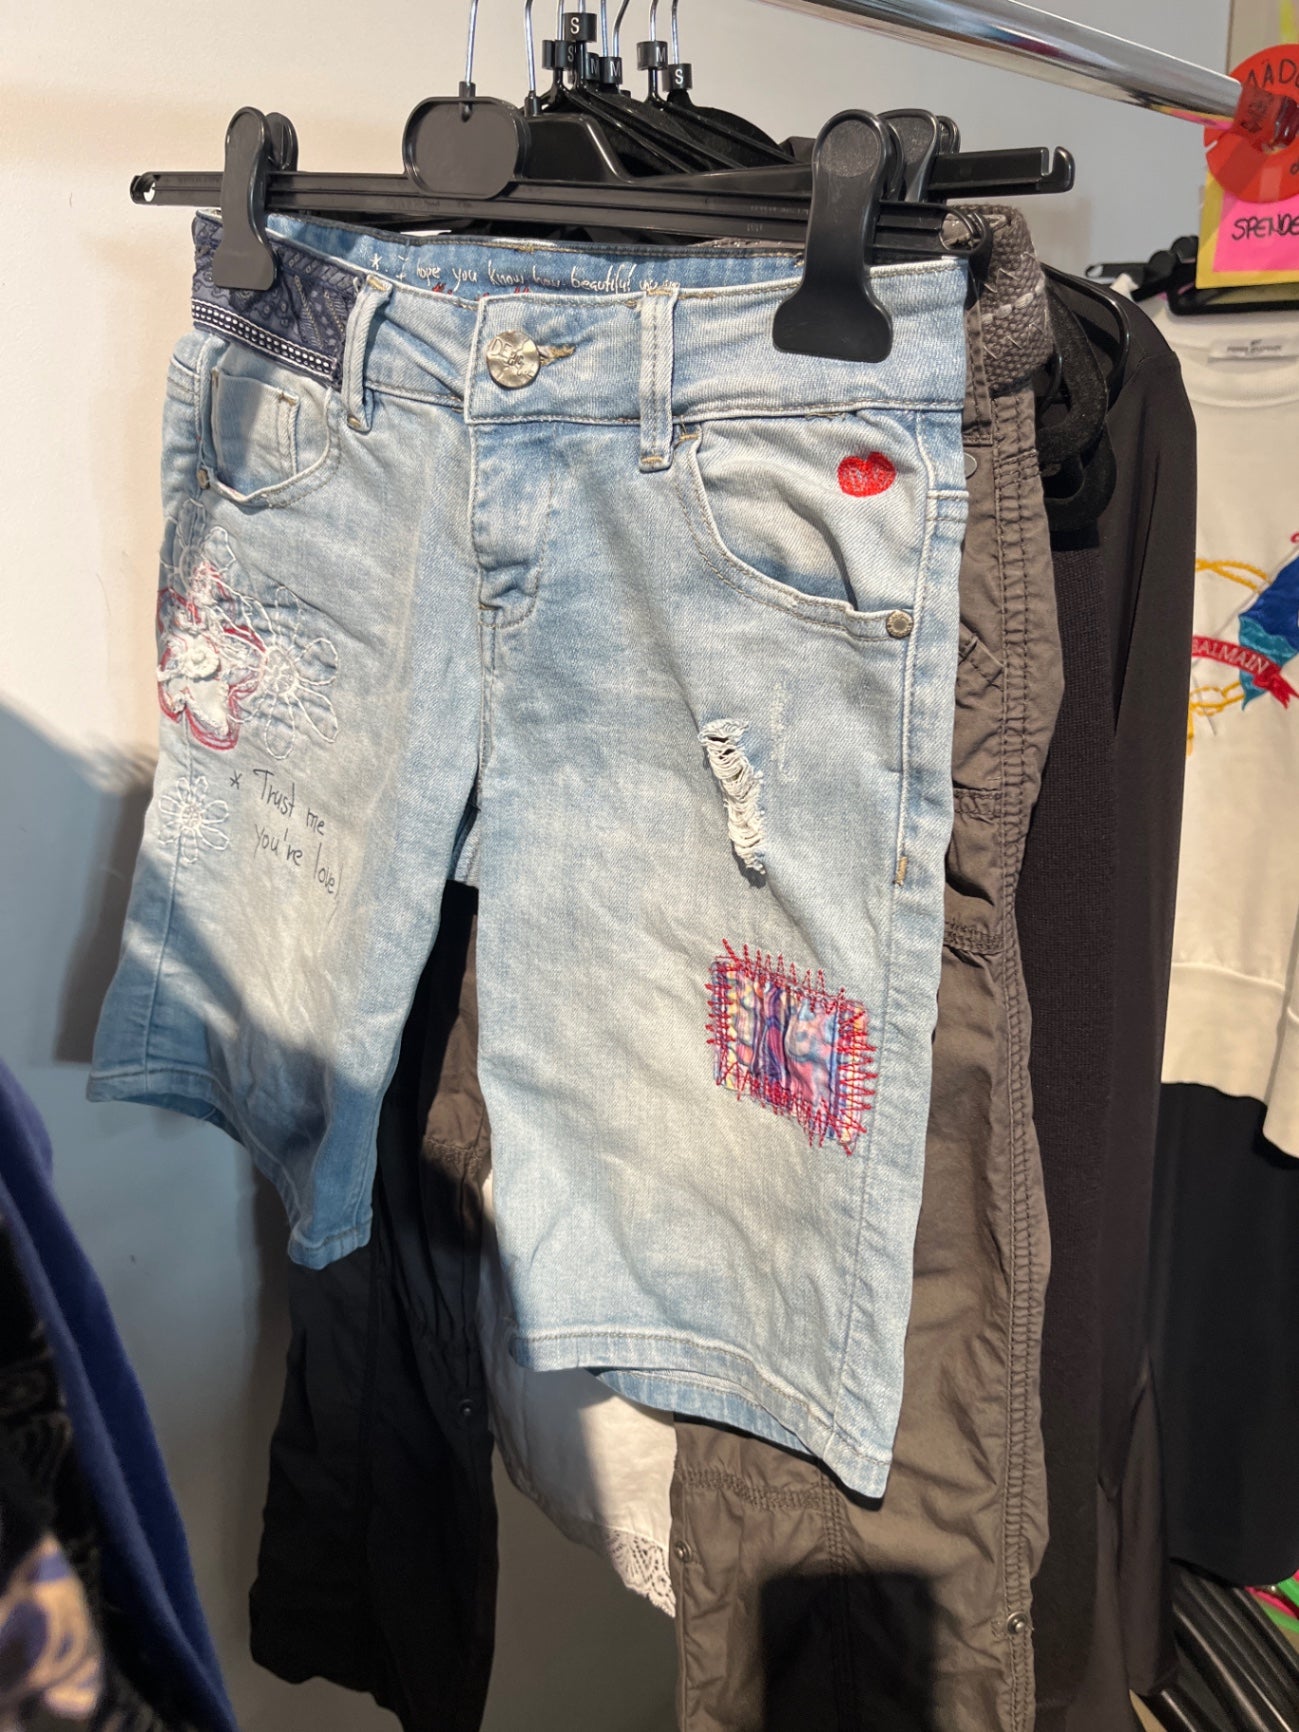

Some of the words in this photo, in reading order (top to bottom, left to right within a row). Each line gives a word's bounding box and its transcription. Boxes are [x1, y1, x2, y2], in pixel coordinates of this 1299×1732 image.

[570, 17, 580, 35] S
[567, 44, 574, 63] S
[655, 48, 667, 63] M
[609, 62, 621, 77] M
[674, 68, 684, 85] S
[417, 257, 441, 287] hope
[452, 267, 478, 293] you
[488, 259, 525, 286] know
[252, 768, 295, 818] Trust
[306, 807, 325, 837] me
